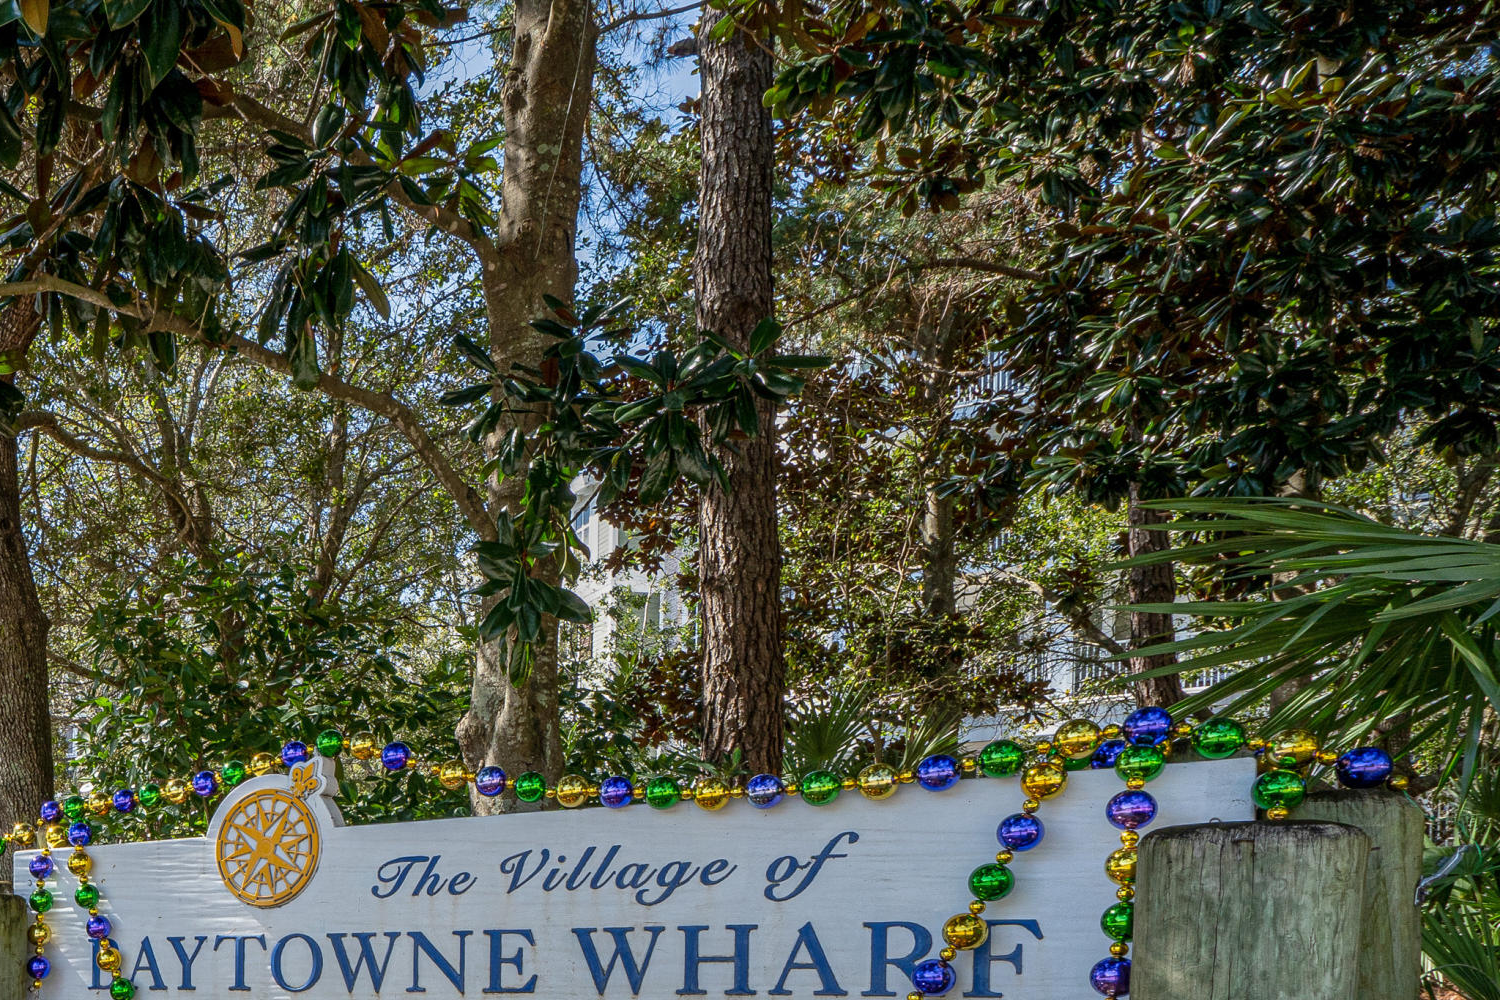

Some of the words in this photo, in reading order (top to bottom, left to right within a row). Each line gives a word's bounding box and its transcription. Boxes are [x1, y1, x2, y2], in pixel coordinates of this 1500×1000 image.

[371, 854, 477, 898] The
[500, 844, 737, 906] Village
[763, 831, 860, 902] of
[571, 918, 1044, 998] WHARF
